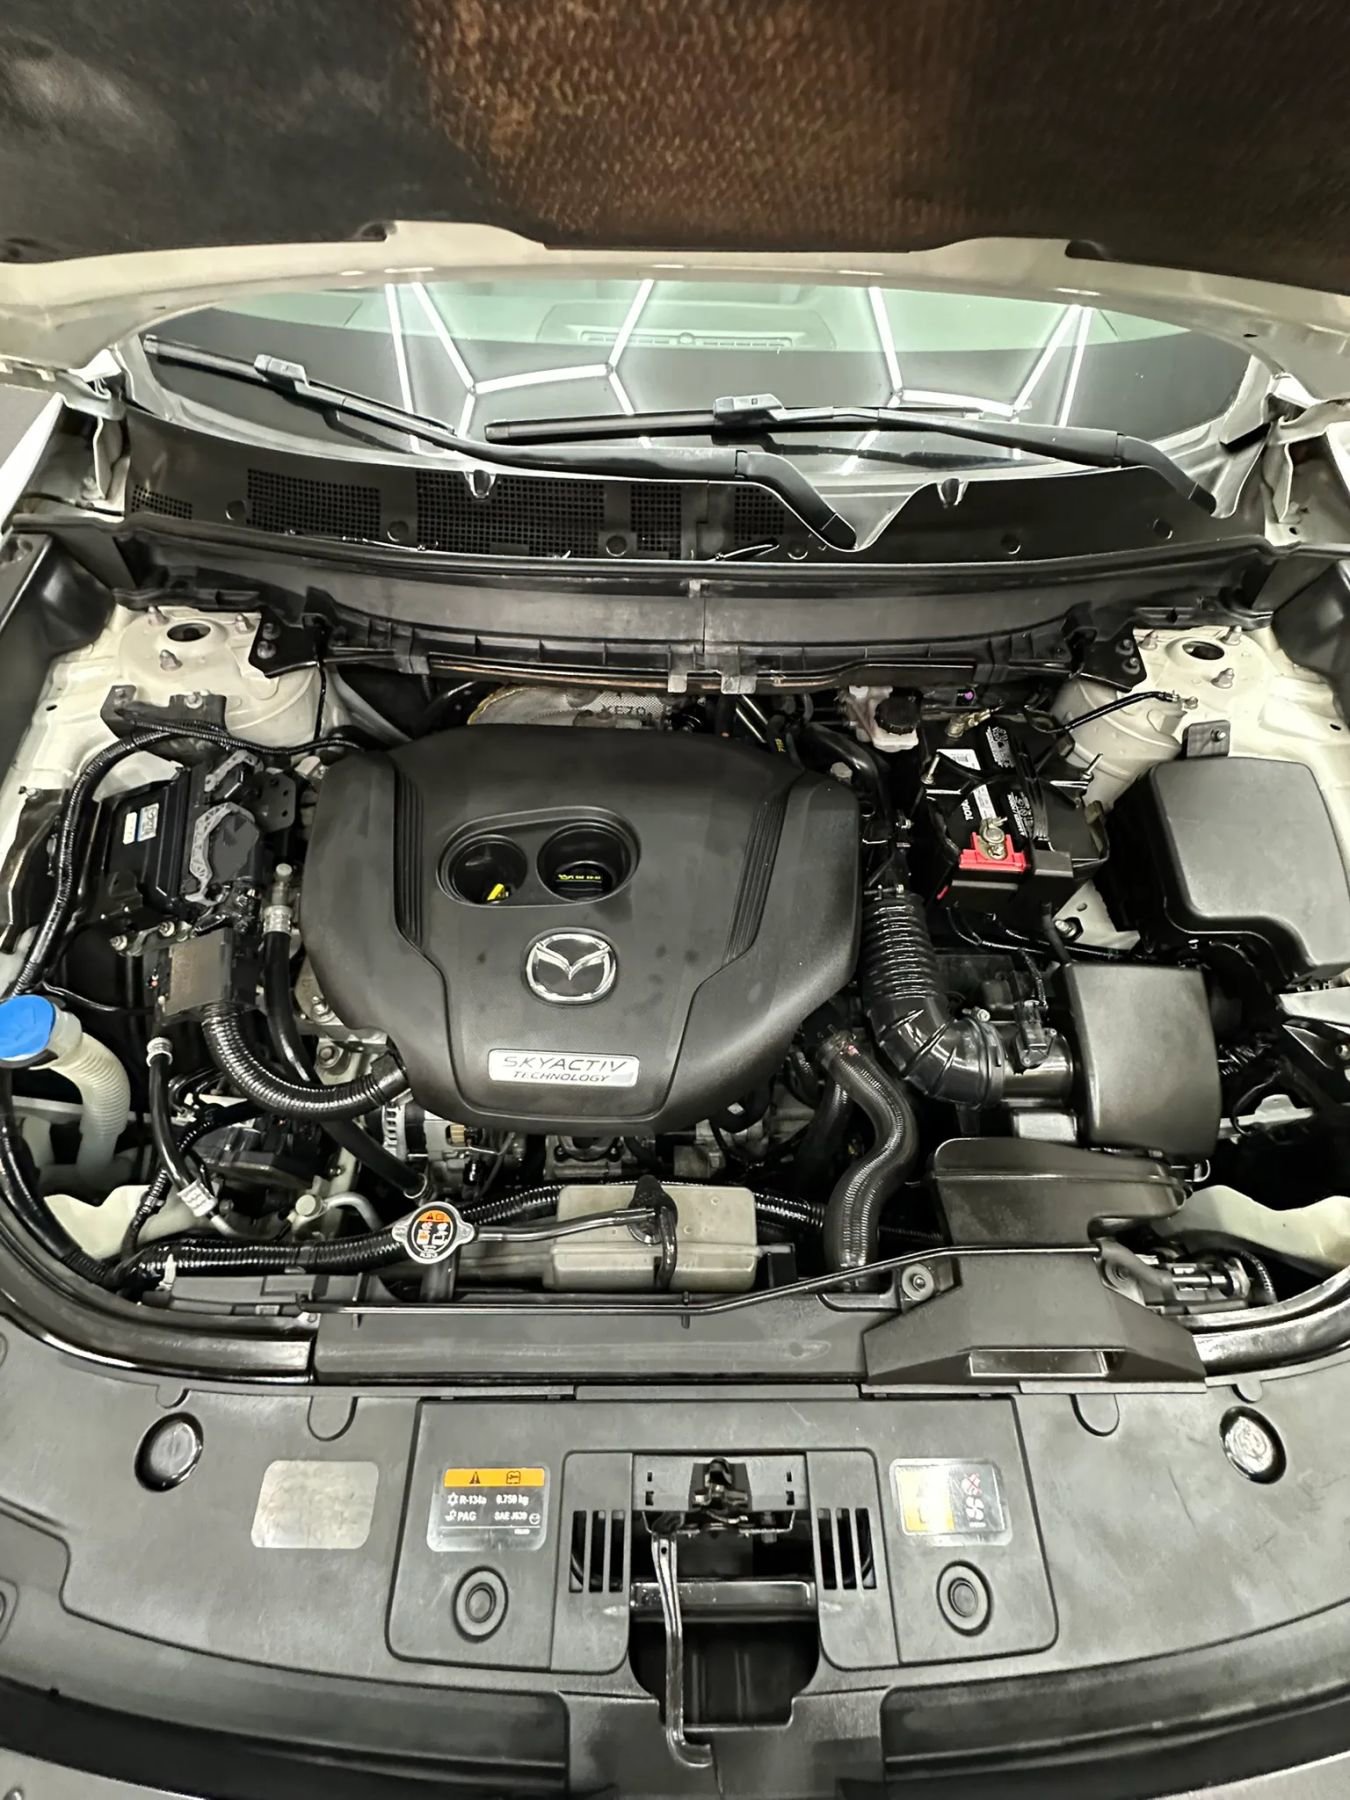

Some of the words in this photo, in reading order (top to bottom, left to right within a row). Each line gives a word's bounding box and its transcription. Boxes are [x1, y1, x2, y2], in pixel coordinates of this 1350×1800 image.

[503, 1055, 627, 1072] SKYACTIV
[513, 1070, 610, 1082] TECHNOLOGY
[457, 1511, 477, 1522] PAG
[494, 1511, 510, 1521] SAE
